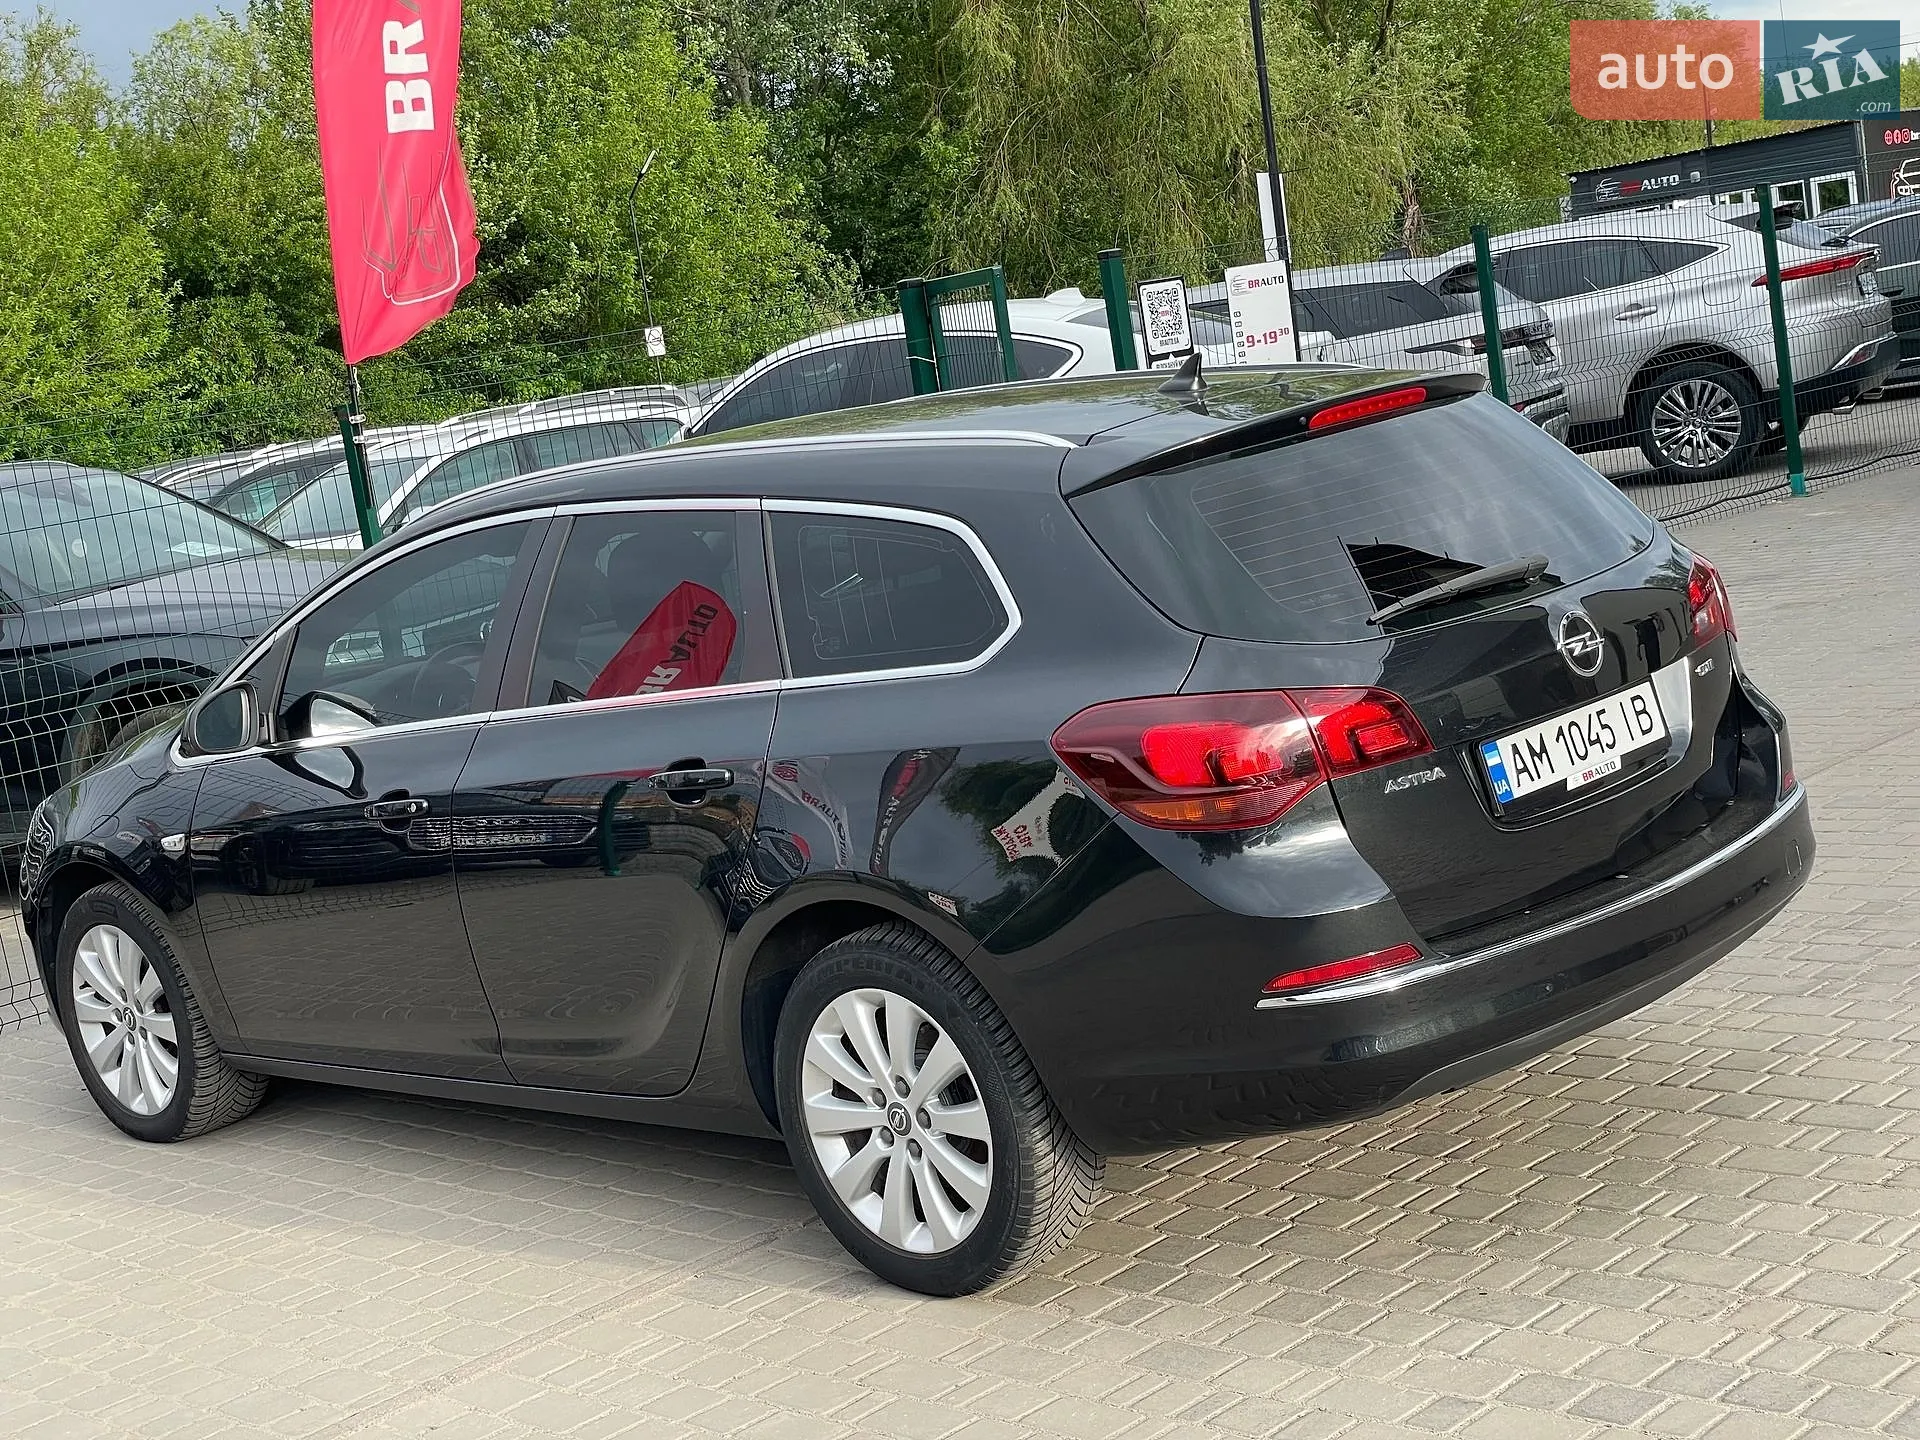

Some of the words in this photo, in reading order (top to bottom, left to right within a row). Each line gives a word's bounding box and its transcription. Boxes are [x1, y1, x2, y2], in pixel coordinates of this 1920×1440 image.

[383, 0, 435, 134] BR
[1247, 275, 1285, 289] BRAUTO
[1511, 732, 1556, 788] AM
[1556, 708, 1617, 766] 1045
[1384, 766, 1447, 794] ASTRA
[1582, 760, 1617, 782] BRAUTO
[1494, 781, 1511, 796] UA
